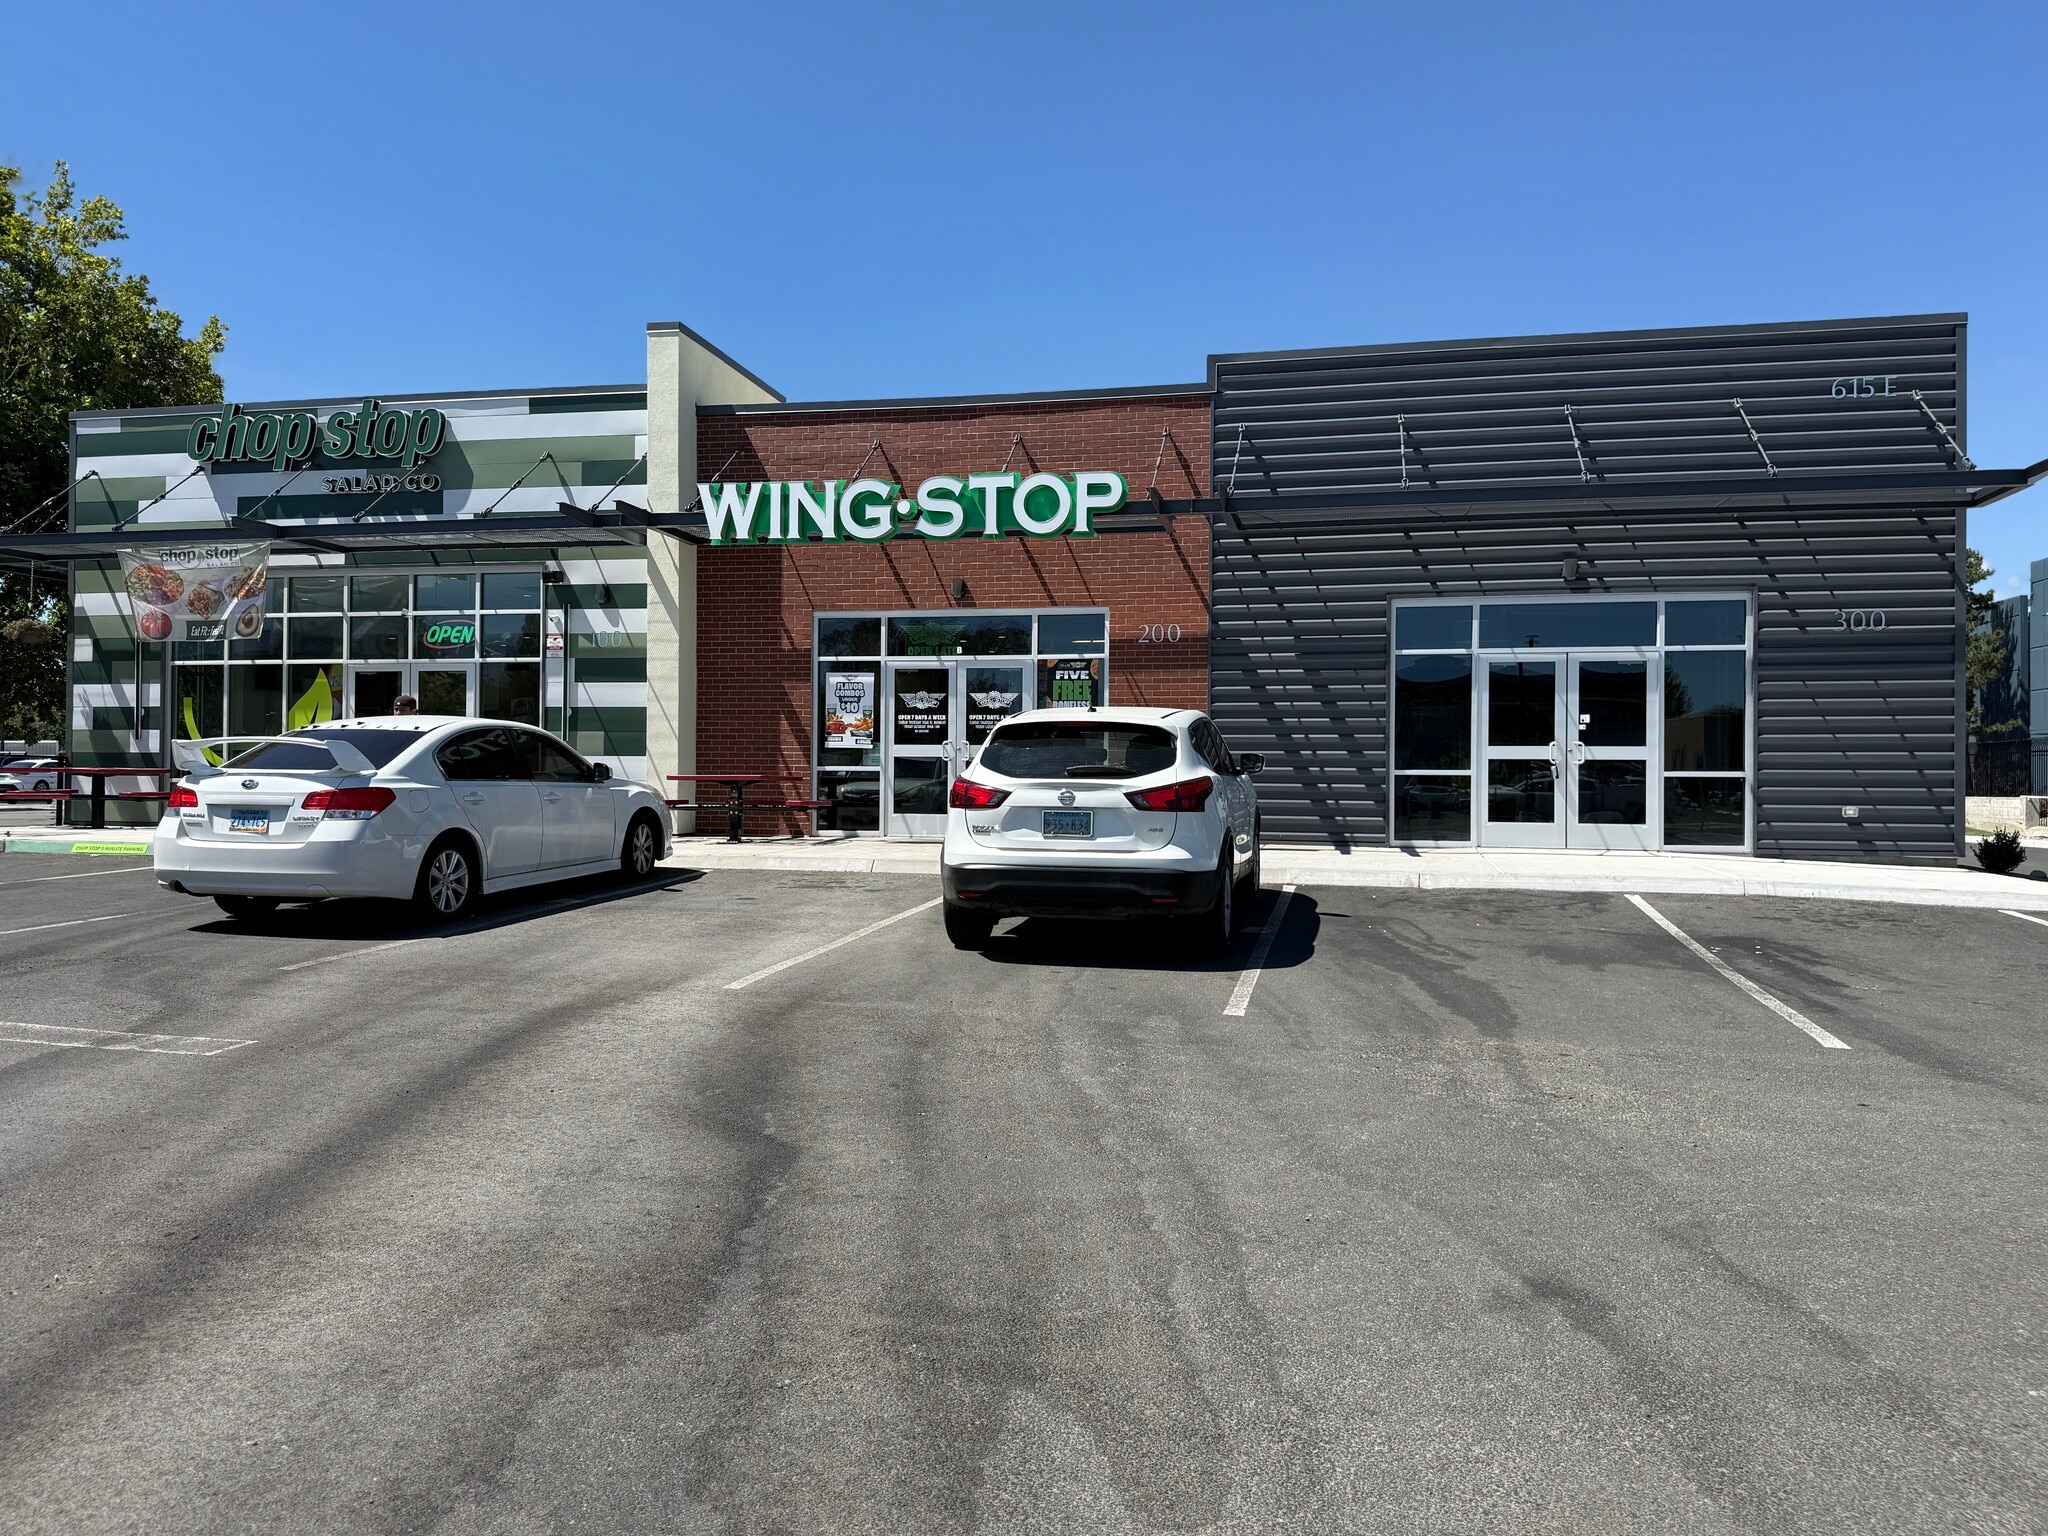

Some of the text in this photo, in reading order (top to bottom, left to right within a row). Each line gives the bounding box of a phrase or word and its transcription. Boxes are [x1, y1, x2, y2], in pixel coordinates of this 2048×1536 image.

[1831, 375, 1899, 399] 615 E
[187, 399, 447, 472] chop stop
[322, 473, 440, 492] SALAD CO
[161, 546, 239, 563] chop stop
[1833, 610, 1886, 632] 300
[426, 625, 475, 644] OPEN
[592, 631, 623, 648] 100
[1138, 623, 1181, 643] 200
[907, 646, 933, 656] OPEN
[1055, 670, 1090, 680] FIVE
[1052, 680, 1092, 701] FREE
[841, 702, 859, 713] $10
